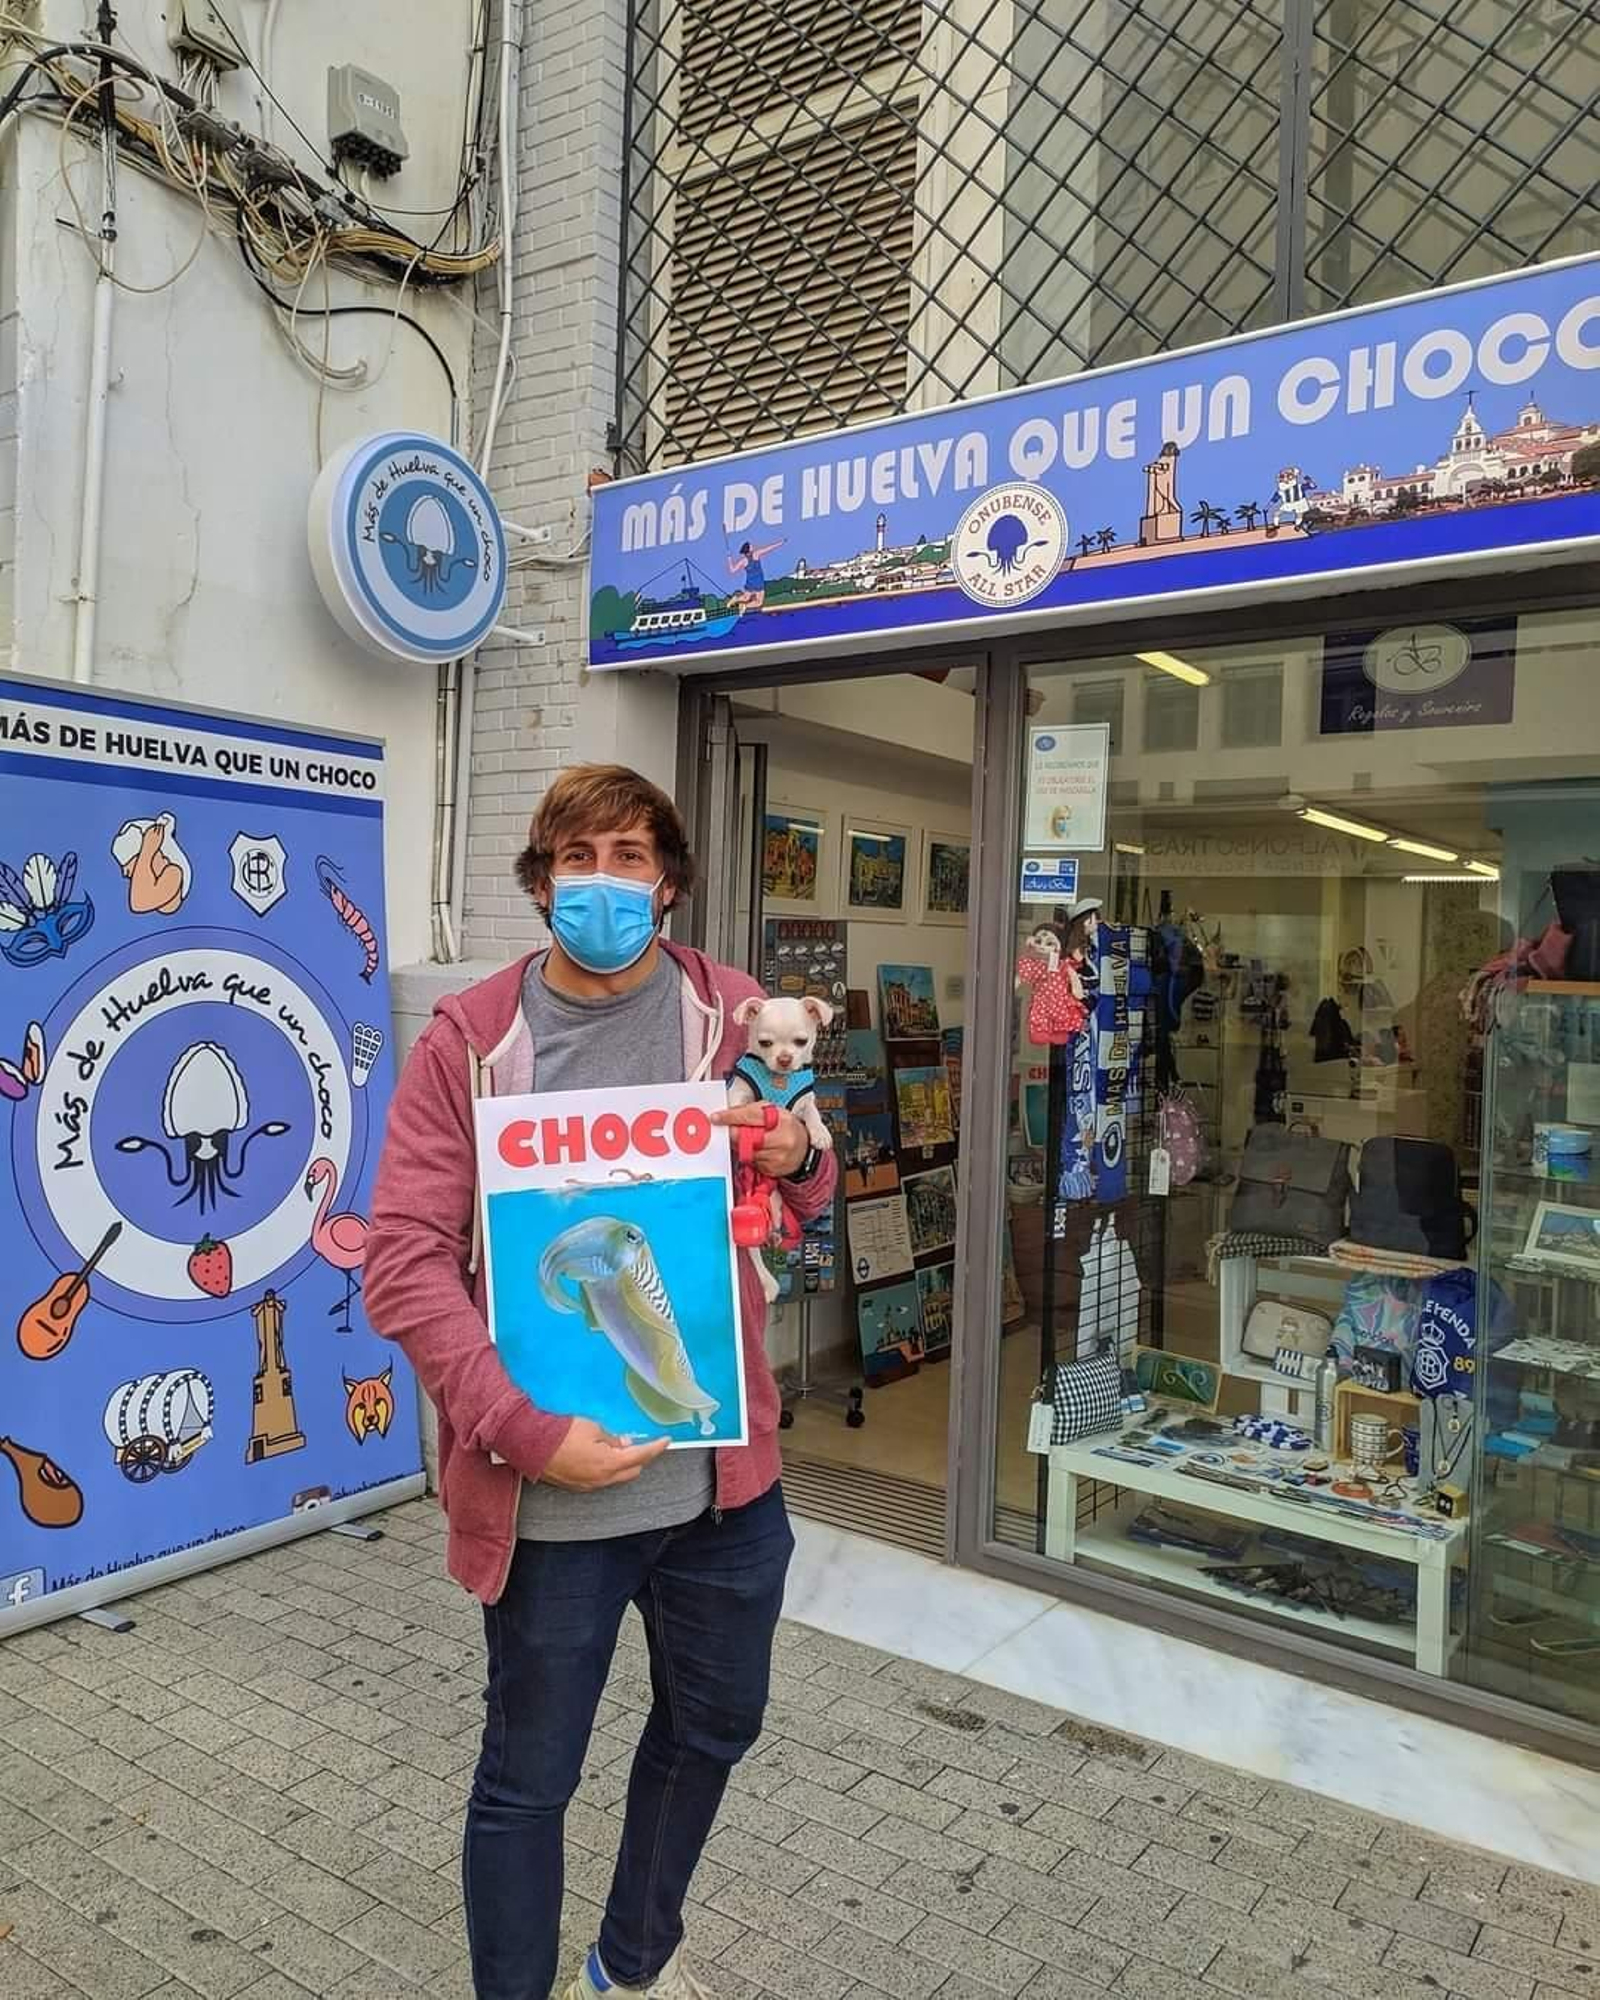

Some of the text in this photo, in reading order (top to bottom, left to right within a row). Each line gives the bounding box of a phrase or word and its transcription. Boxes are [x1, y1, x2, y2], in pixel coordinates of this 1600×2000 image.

[620, 296, 1600, 553] MÁS DE HUELVA QUE UN CHOCO
[362, 455, 493, 582] Más de Huelva que un choco
[968, 494, 1052, 534] ONUBENSE
[967, 563, 1047, 597] ALL STAR
[59, 725, 96, 751] DE
[106, 732, 207, 767] HUELVA
[215, 749, 262, 777] QUE
[269, 758, 300, 781] UN
[306, 764, 376, 790] CHOCO
[54, 968, 334, 1170] Más de Huelva que un choco
[497, 1106, 712, 1168] CHOCO
